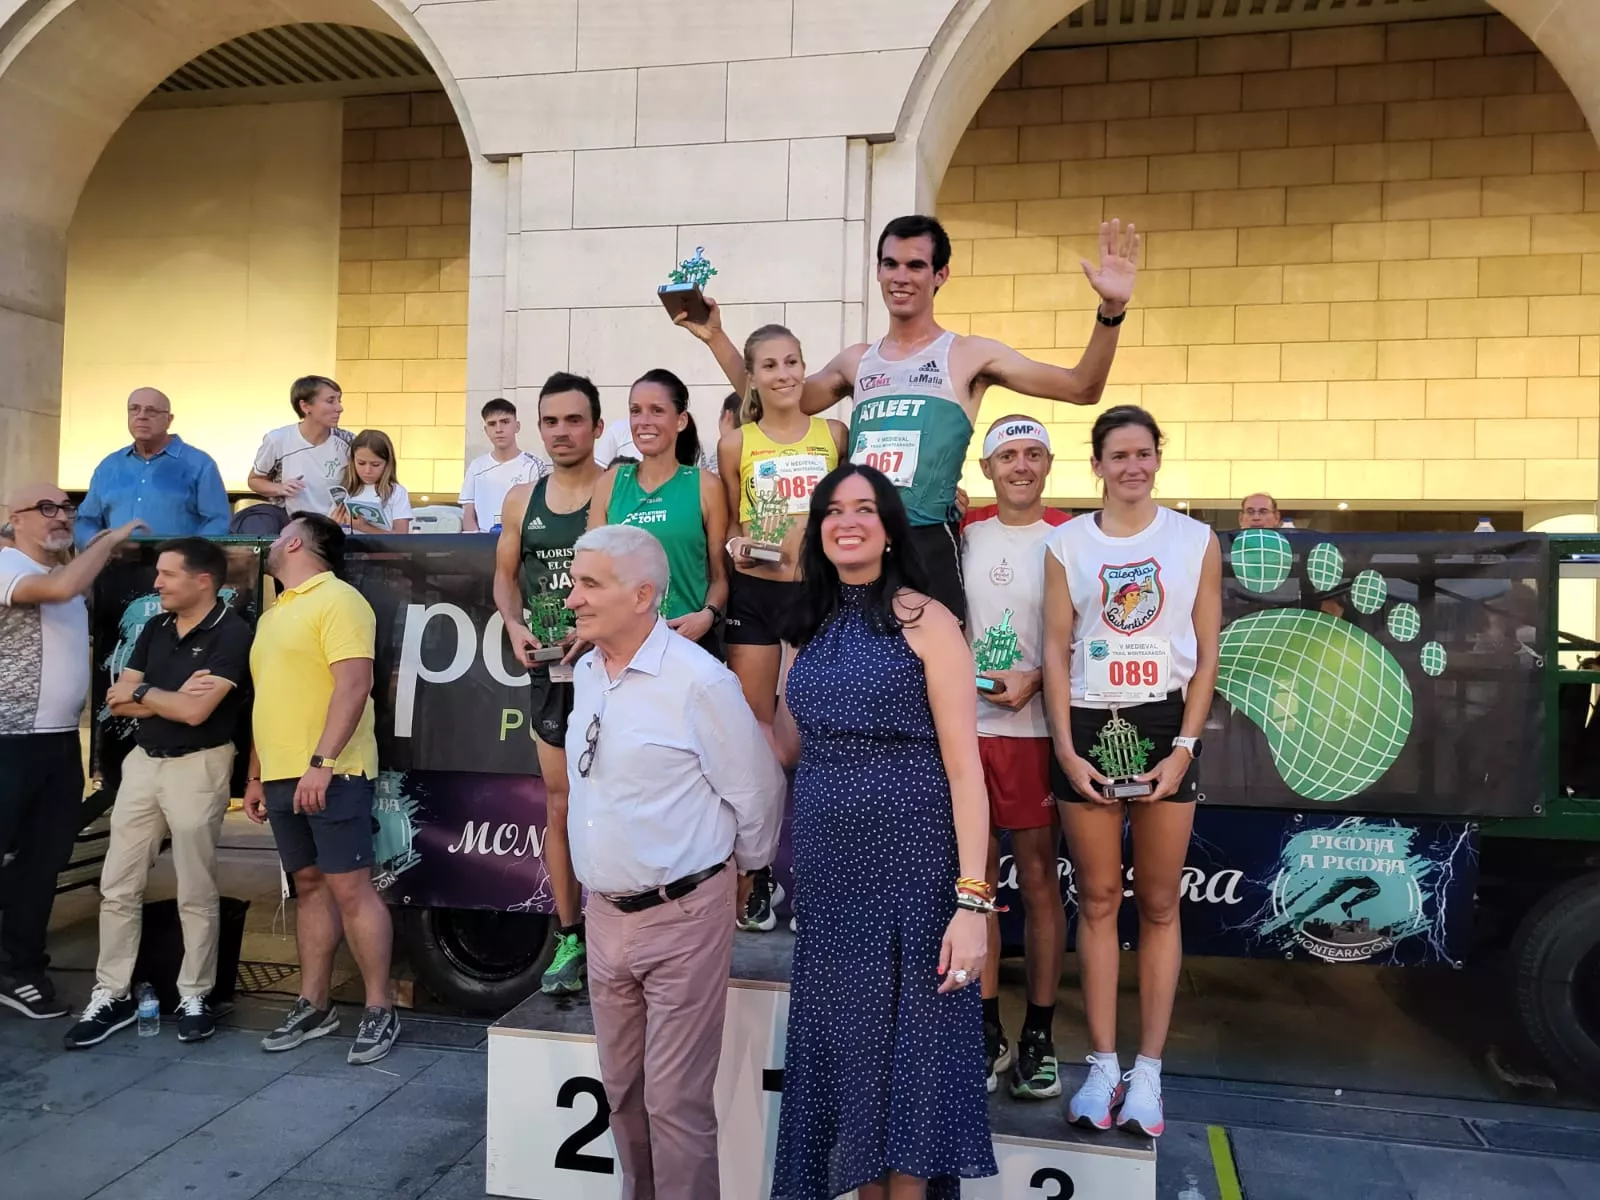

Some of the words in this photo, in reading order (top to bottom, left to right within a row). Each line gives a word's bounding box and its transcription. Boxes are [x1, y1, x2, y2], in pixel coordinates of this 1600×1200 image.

[859, 400, 926, 423] ATLEET
[1006, 425, 1034, 436] GMP
[865, 451, 903, 473] 067
[1109, 661, 1158, 686] 089
[1310, 834, 1396, 856] PIEDRA
[1300, 854, 1315, 869] A
[1322, 855, 1407, 875] PIEDRA
[1292, 933, 1394, 958] MONTEARAGÓN
[555, 1076, 615, 1175] 2
